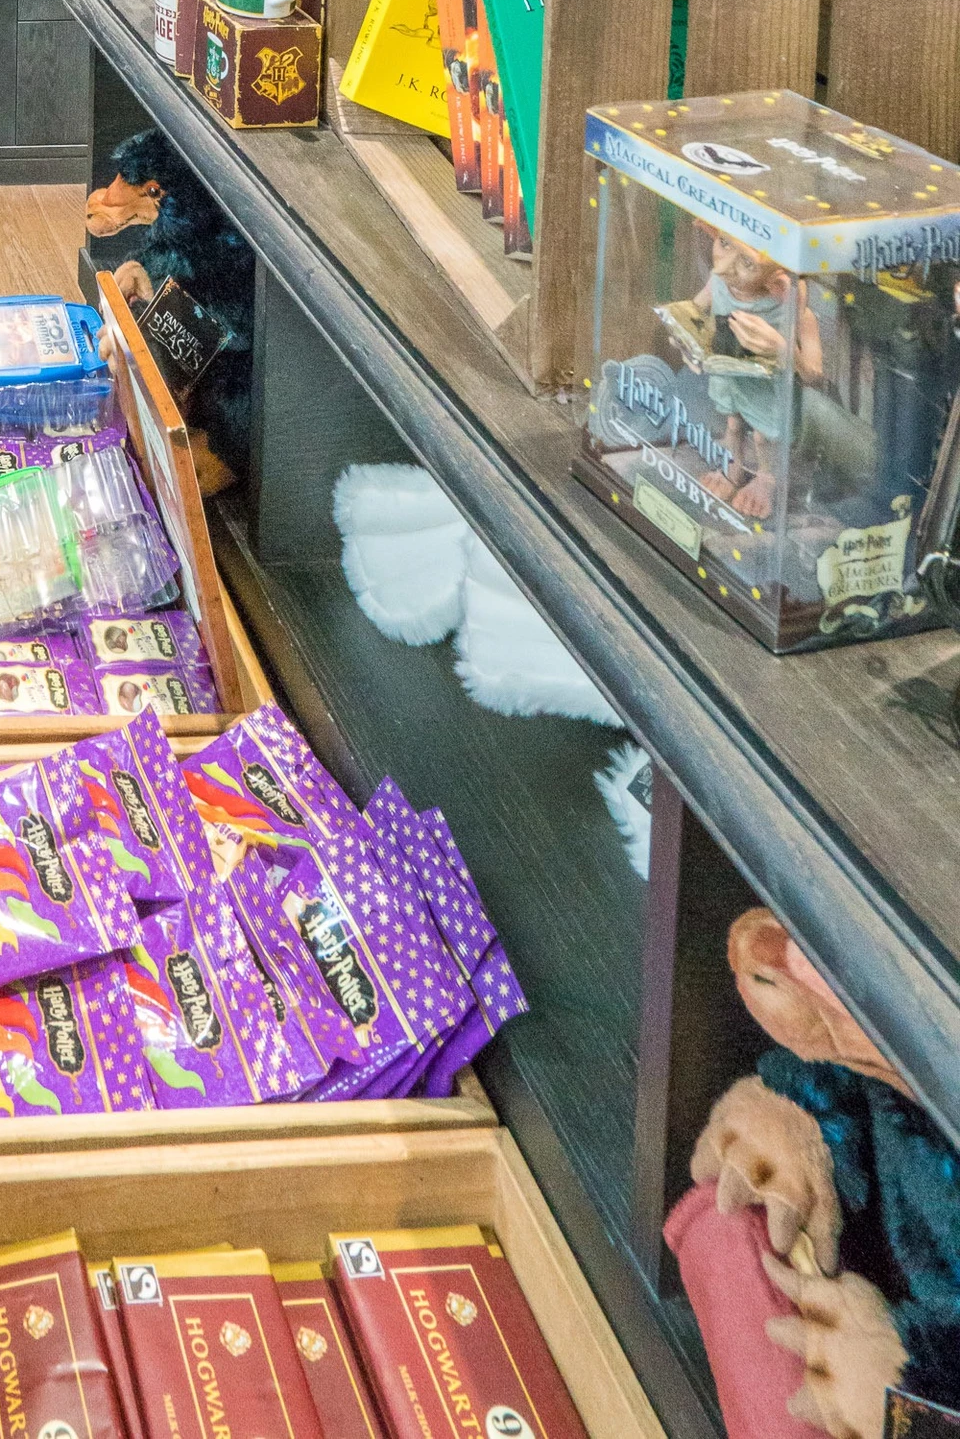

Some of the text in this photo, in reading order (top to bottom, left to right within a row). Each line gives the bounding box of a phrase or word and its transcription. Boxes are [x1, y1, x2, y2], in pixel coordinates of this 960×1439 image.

[355, 18, 376, 65] ROWLING
[395, 72, 423, 95] J.K.
[457, 111, 467, 165] ROWLING
[604, 131, 773, 241] MAGICAL CREATURES
[34, 314, 56, 356] TRUMPS
[50, 313, 71, 356] TOP
[147, 311, 203, 371] BEASTS
[161, 311, 203, 351] FANTASTIC
[617, 363, 734, 477] Harry Potter
[641, 444, 716, 514] DOBBY
[827, 575, 902, 598] CREATURES
[838, 561, 892, 579] MAGICAL
[116, 774, 154, 842] Harry Potter
[26, 818, 66, 903] Harry Potter
[172, 958, 198, 997] Harry
[306, 913, 367, 1023] Harry Potter
[42, 985, 76, 1066] Harry Potter
